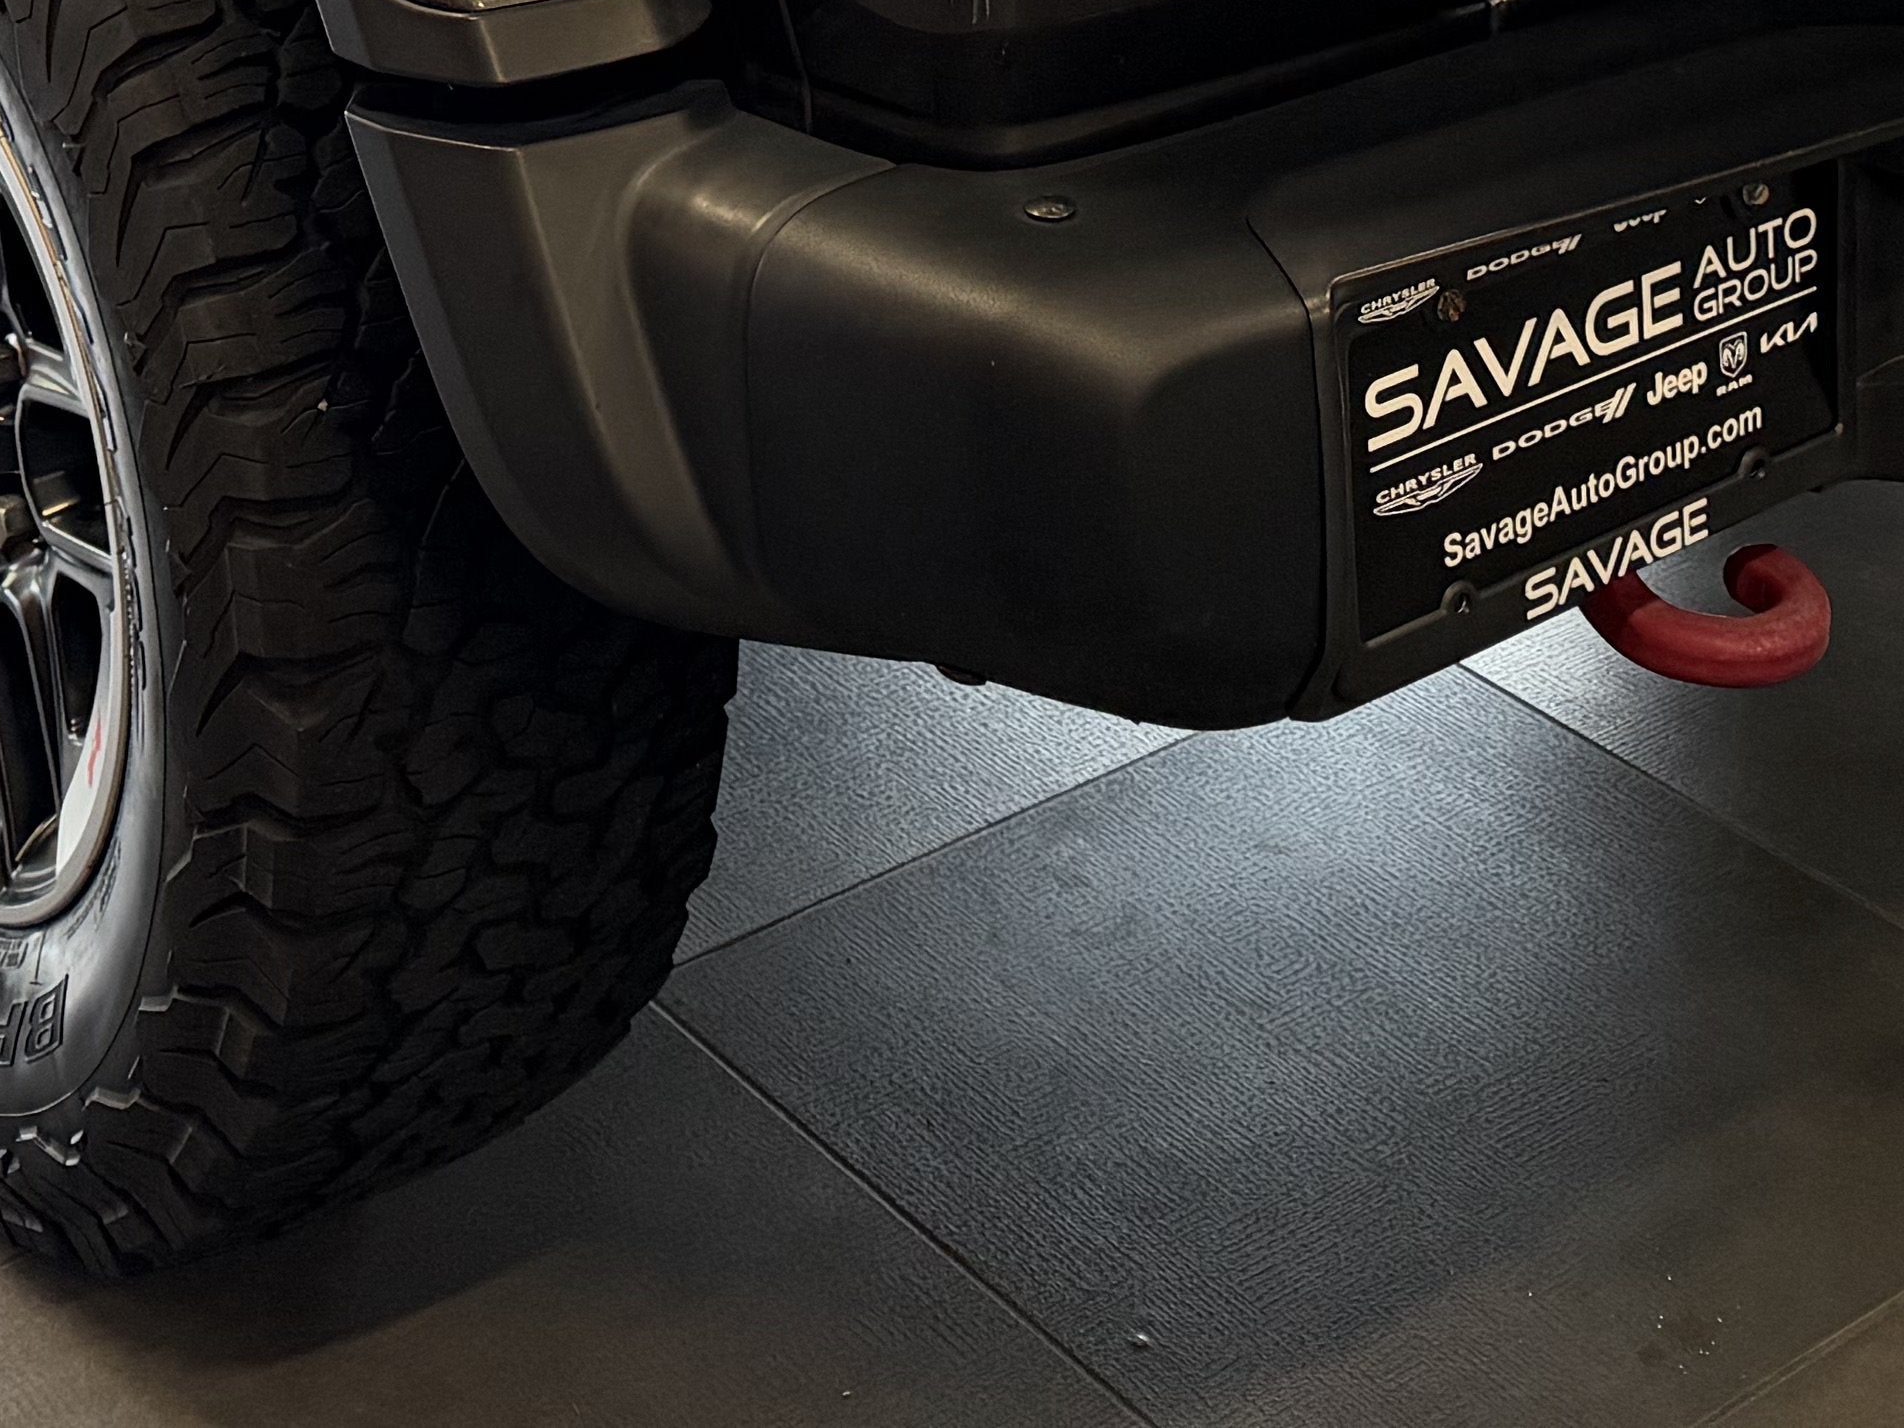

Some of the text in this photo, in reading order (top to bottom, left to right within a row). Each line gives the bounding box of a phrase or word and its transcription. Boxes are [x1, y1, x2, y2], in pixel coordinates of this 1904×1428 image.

[1360, 277, 1436, 315] CHRYSLER
[1693, 207, 1817, 289] AUTO
[1693, 249, 1818, 323] GROUP
[1364, 261, 1683, 453] SAVAGE
[1375, 451, 1477, 506] CHRYSLER
[1492, 400, 1618, 460] DODGE
[1646, 360, 1709, 407] Jeep
[1715, 374, 1753, 397] RAM
[1443, 403, 1763, 568] SavageAutoGroup.com
[1524, 497, 1710, 621] SAVAGE
